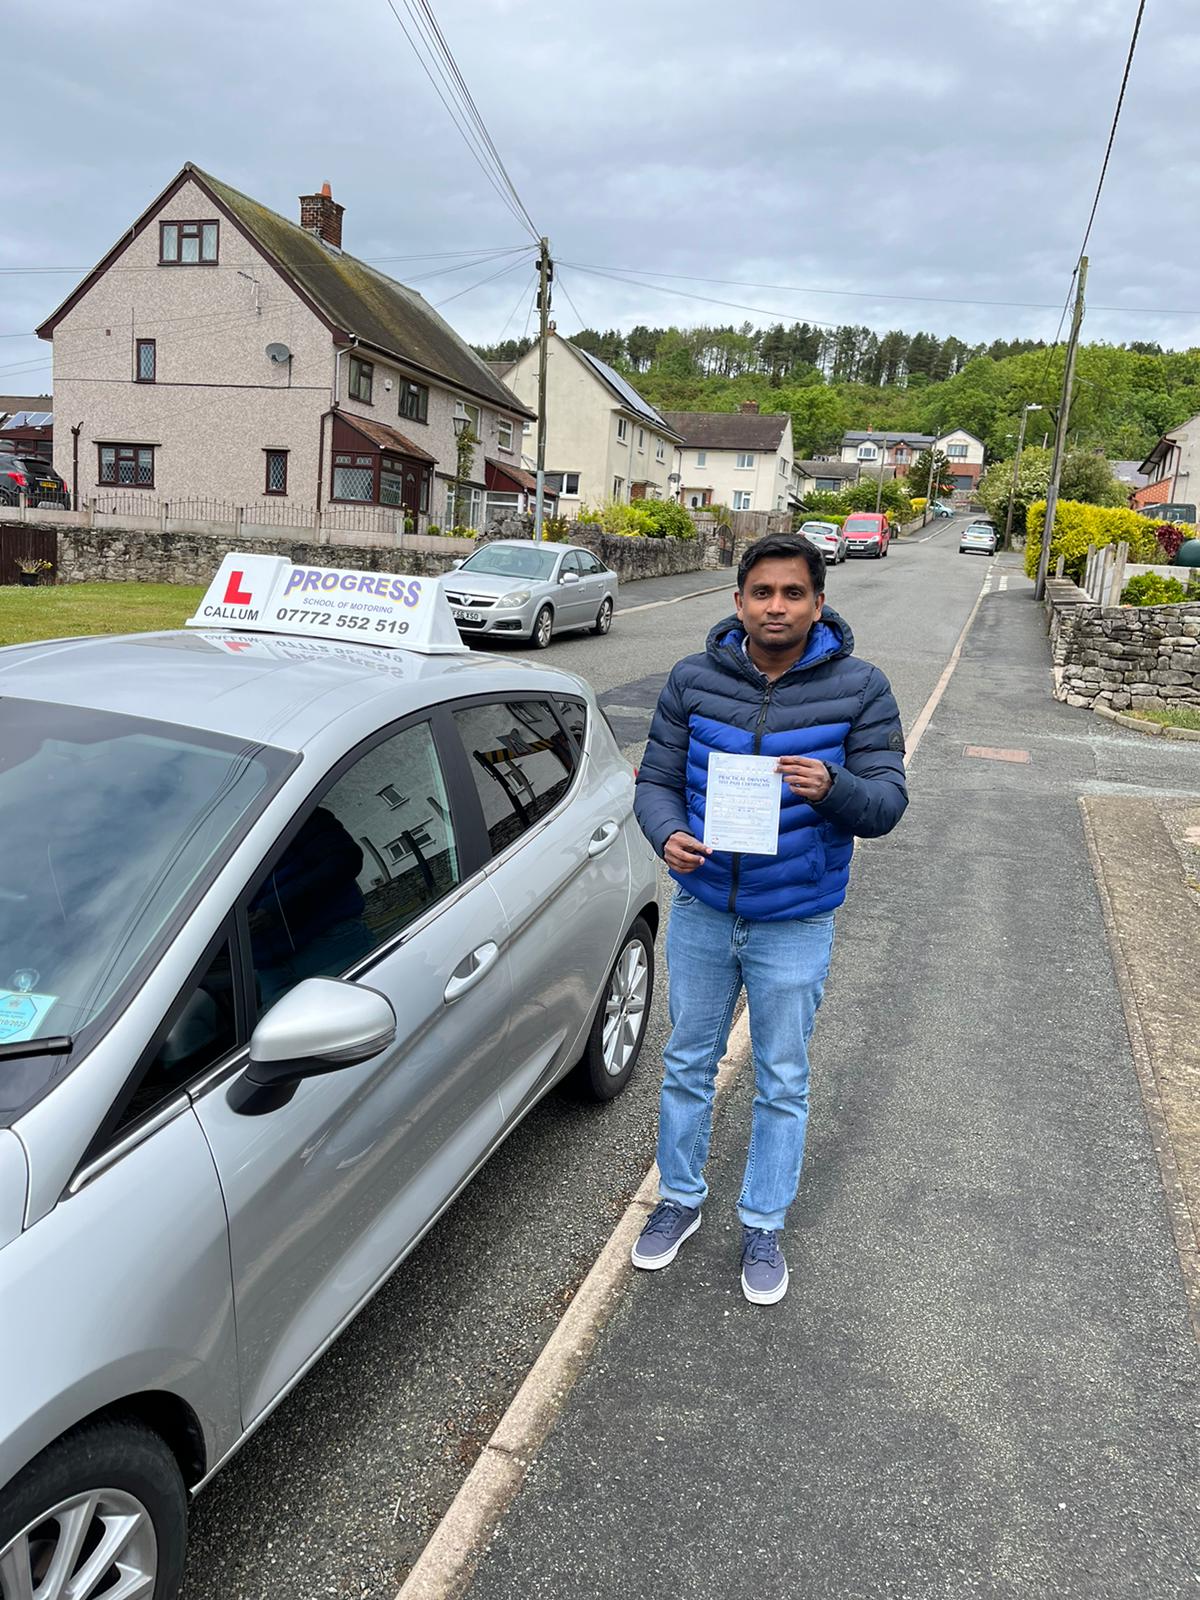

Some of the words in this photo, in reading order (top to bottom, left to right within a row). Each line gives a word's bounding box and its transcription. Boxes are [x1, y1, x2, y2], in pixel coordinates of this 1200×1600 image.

[223, 571, 252, 605] L
[283, 569, 422, 608] PROGRESS
[204, 606, 259, 621] CALLUM
[303, 597, 335, 608] SCHOOL
[350, 603, 394, 614] MOTORING
[276, 608, 331, 626] 07772
[336, 615, 370, 630] 552
[375, 620, 409, 635] 519
